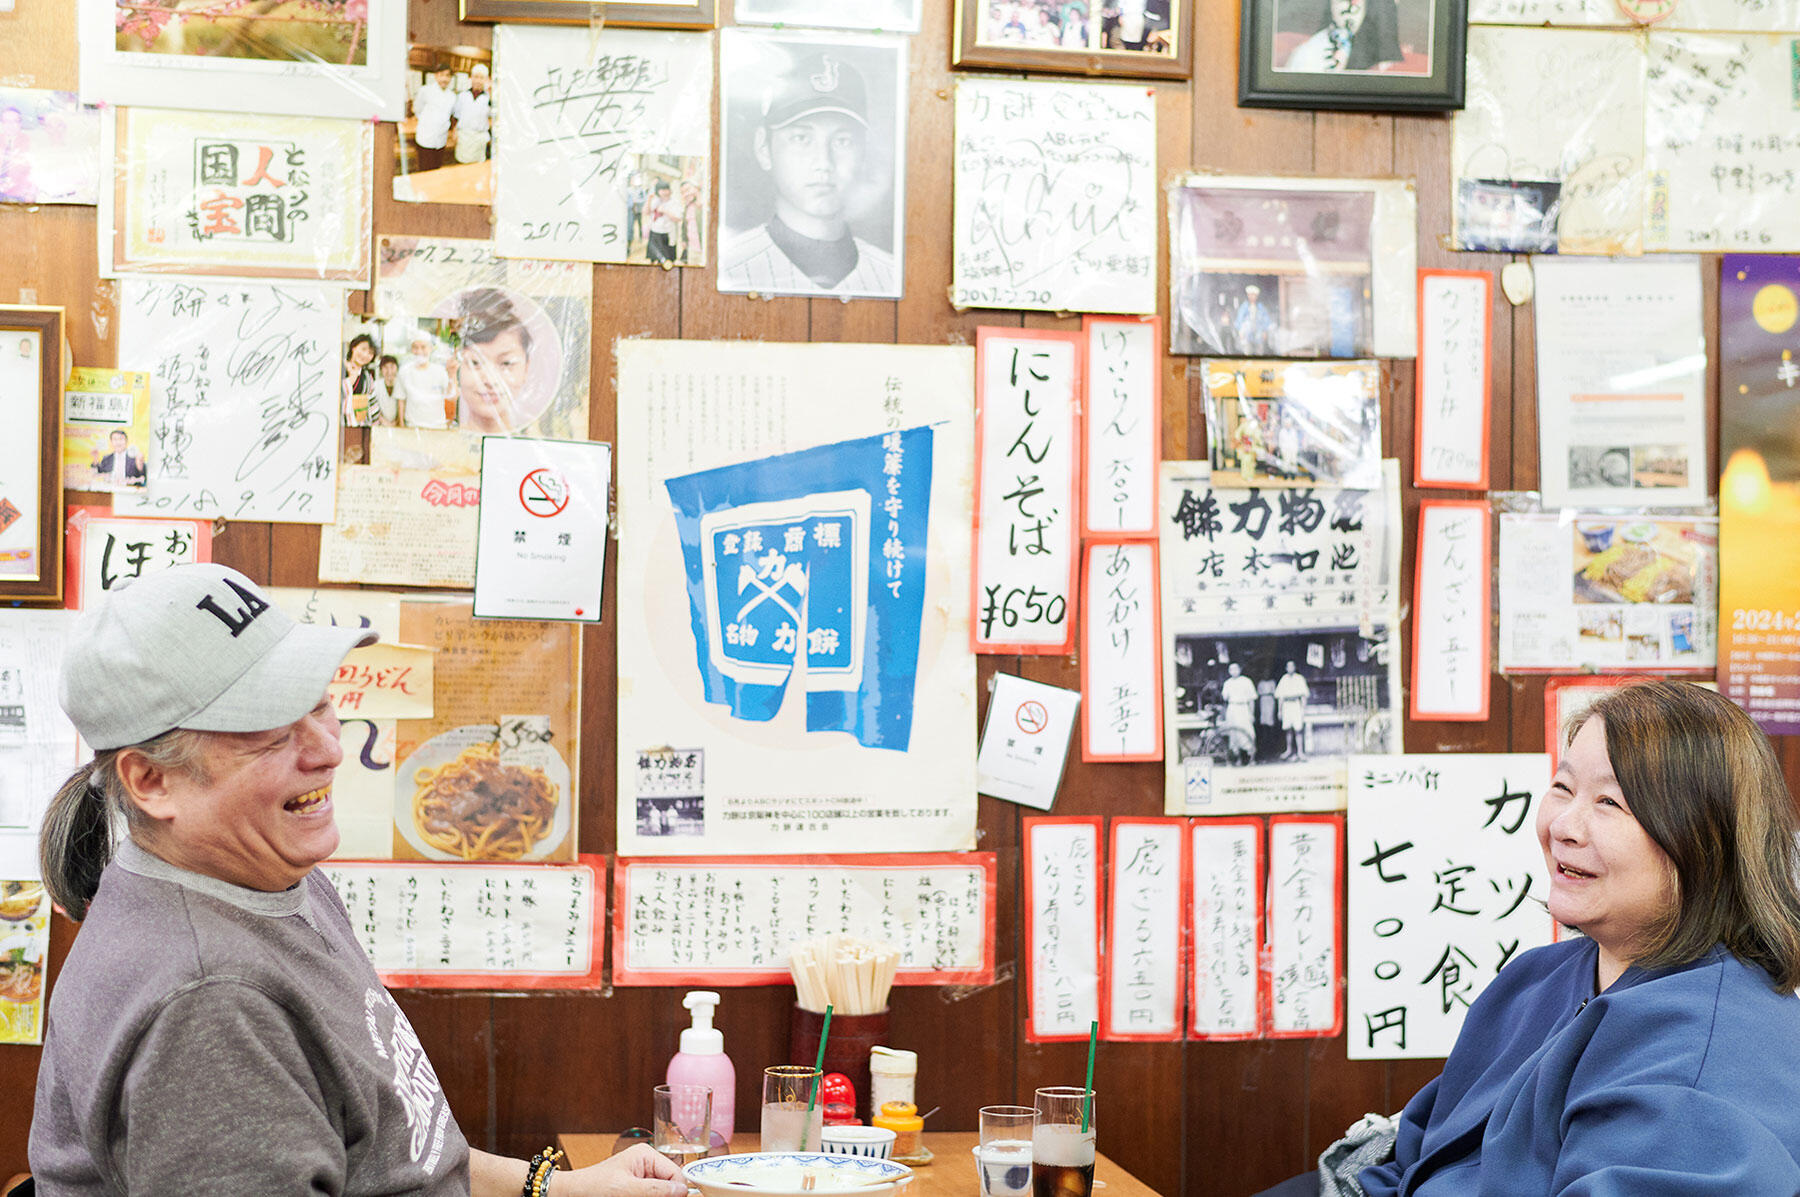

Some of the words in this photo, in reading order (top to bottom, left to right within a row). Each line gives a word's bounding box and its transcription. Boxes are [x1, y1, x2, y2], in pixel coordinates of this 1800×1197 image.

[200, 144, 244, 235] 国宝
[243, 146, 286, 241] 人間
[287, 149, 309, 222] となりの
[1002, 347, 1058, 556] にしんそば
[513, 530, 572, 547] 禁煙
[196, 578, 270, 638] LA
[980, 583, 1067, 639] ¥650
[1420, 858, 1482, 1015] 定食
